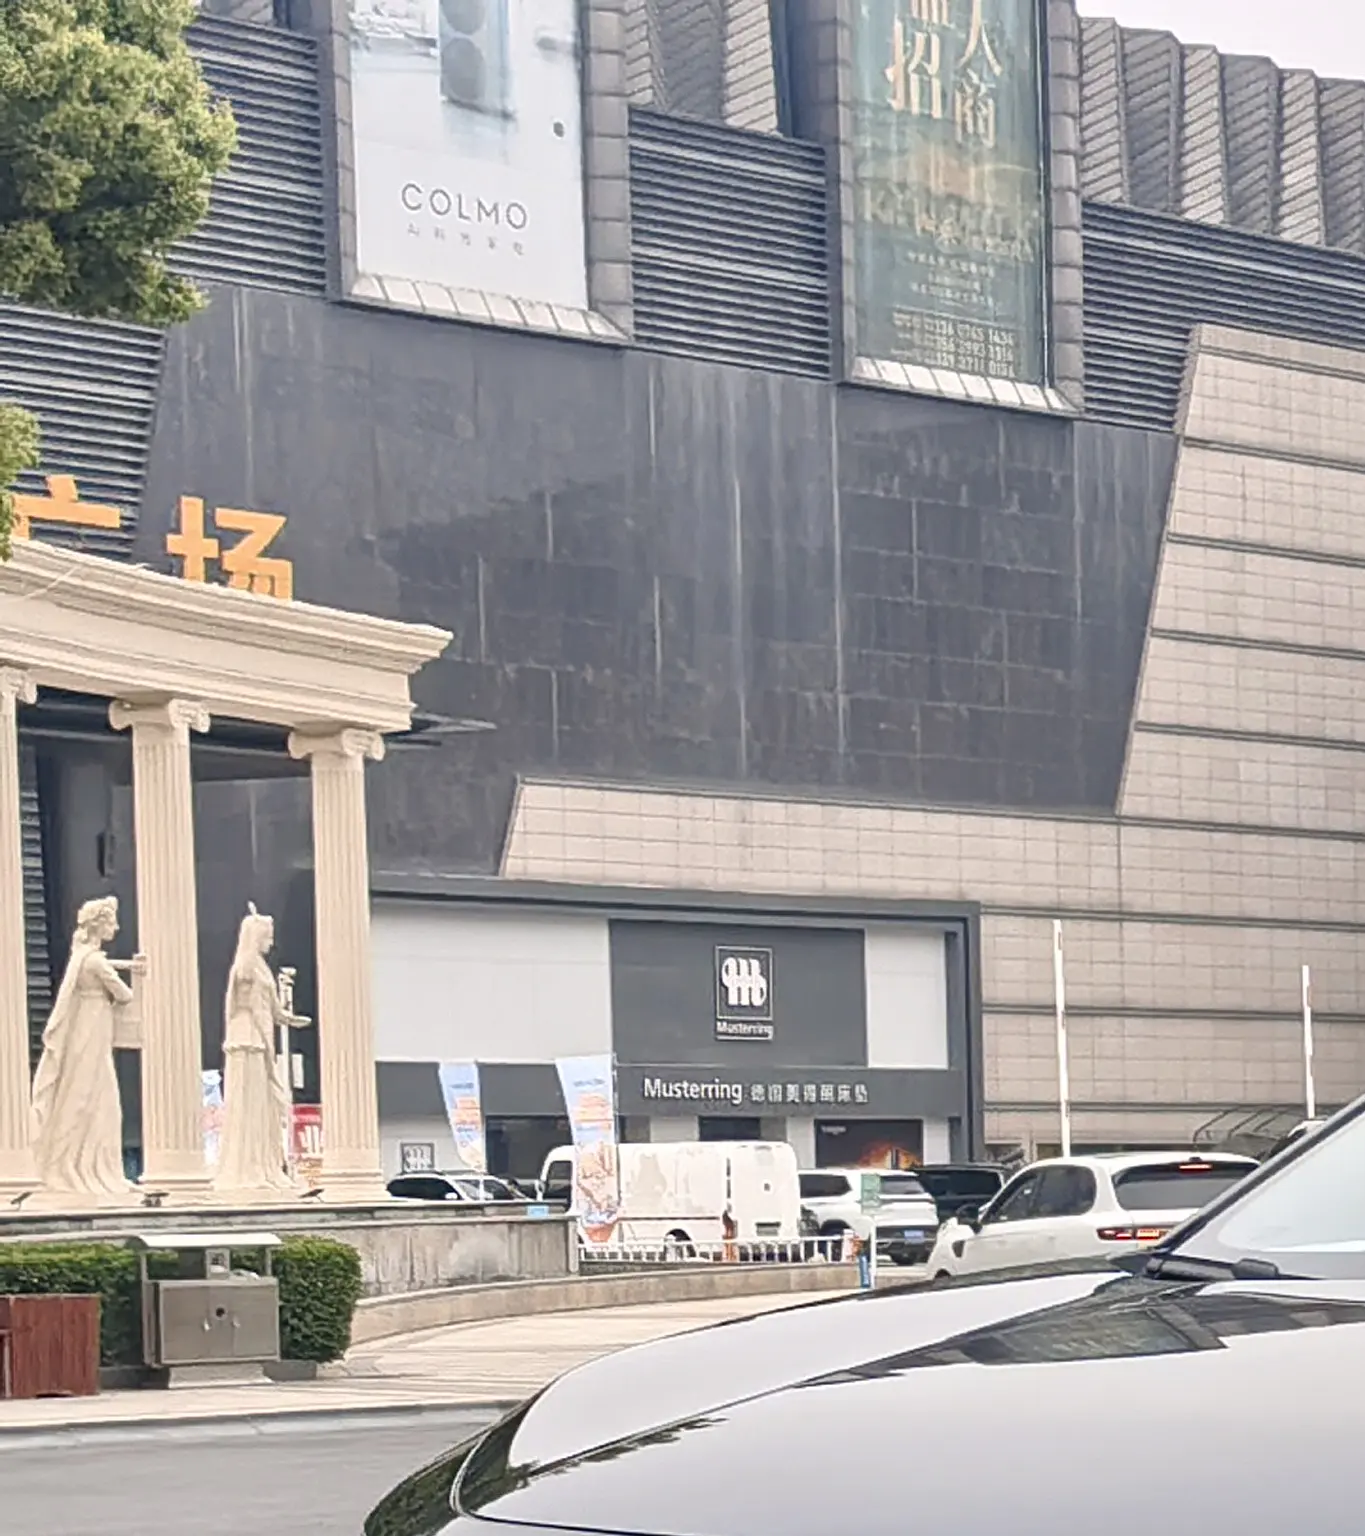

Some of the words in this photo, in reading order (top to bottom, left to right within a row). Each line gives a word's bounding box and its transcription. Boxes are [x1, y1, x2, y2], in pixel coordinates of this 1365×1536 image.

[401, 183, 528, 229] COLMO
[716, 1021, 774, 1037] Musterring
[643, 1078, 743, 1105] Musterring
